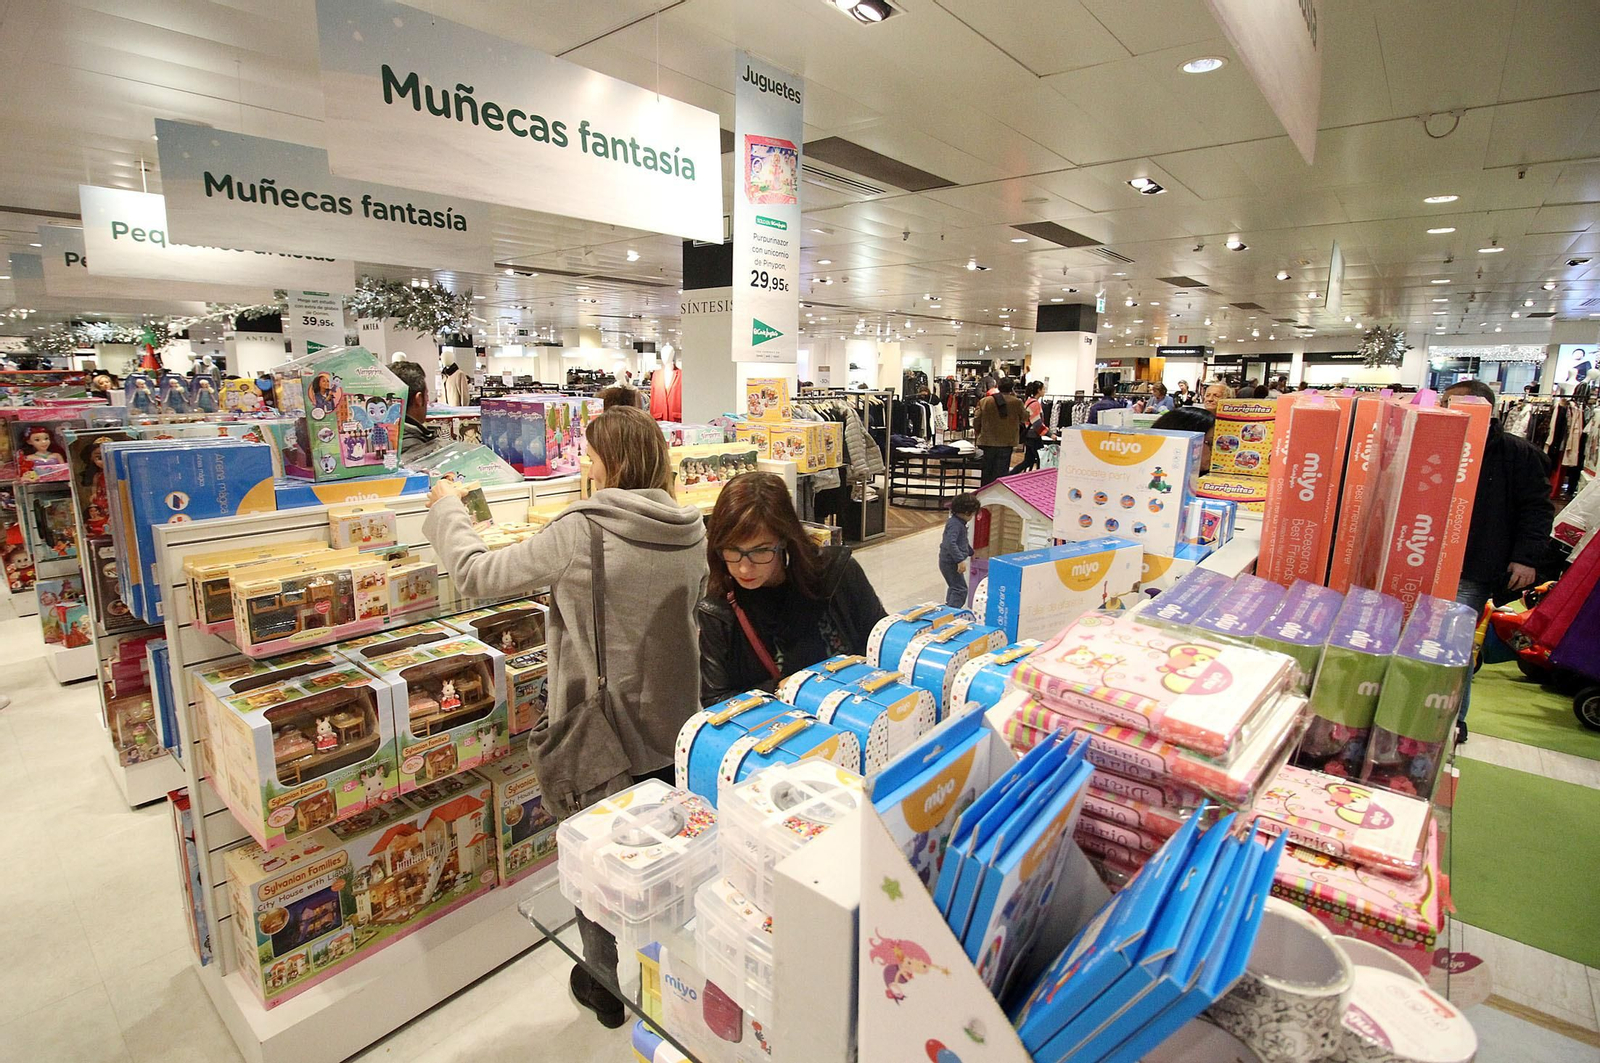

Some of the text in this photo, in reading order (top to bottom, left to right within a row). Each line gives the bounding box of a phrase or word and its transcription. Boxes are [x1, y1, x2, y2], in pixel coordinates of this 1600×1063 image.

[742, 64, 801, 104] Juguetes
[380, 63, 697, 182] Muñecas fantasía
[203, 170, 468, 233] Muñecas fantasía
[750, 269, 789, 292] 29,95€
[302, 315, 335, 327] 39,95€
[362, 322, 380, 331] ANTEA
[245, 335, 276, 343] ANTEA
[1223, 404, 1272, 414] Barriguitas
[1099, 438, 1142, 455] miyo
[214, 453, 226, 480] Arena
[1297, 452, 1323, 502] miyo
[1203, 482, 1254, 494] Barriguitas
[1290, 518, 1304, 542] Best
[1450, 498, 1469, 544] Accesorios
[1298, 519, 1318, 575] Accesorios
[1406, 513, 1435, 567] miyo
[1071, 559, 1099, 577] miyo
[1283, 545, 1300, 581] Friends
[404, 736, 448, 756] Sylvanian Families
[271, 782, 323, 807] Sylvanian Families
[504, 790, 535, 807] City House
[508, 777, 536, 795] Sylvanian
[924, 777, 955, 813] miyo
[263, 857, 342, 896] Sylvanian Families
[257, 900, 275, 912] City
[278, 888, 304, 903] House
[307, 878, 325, 890] with
[664, 974, 698, 1001] miyo
